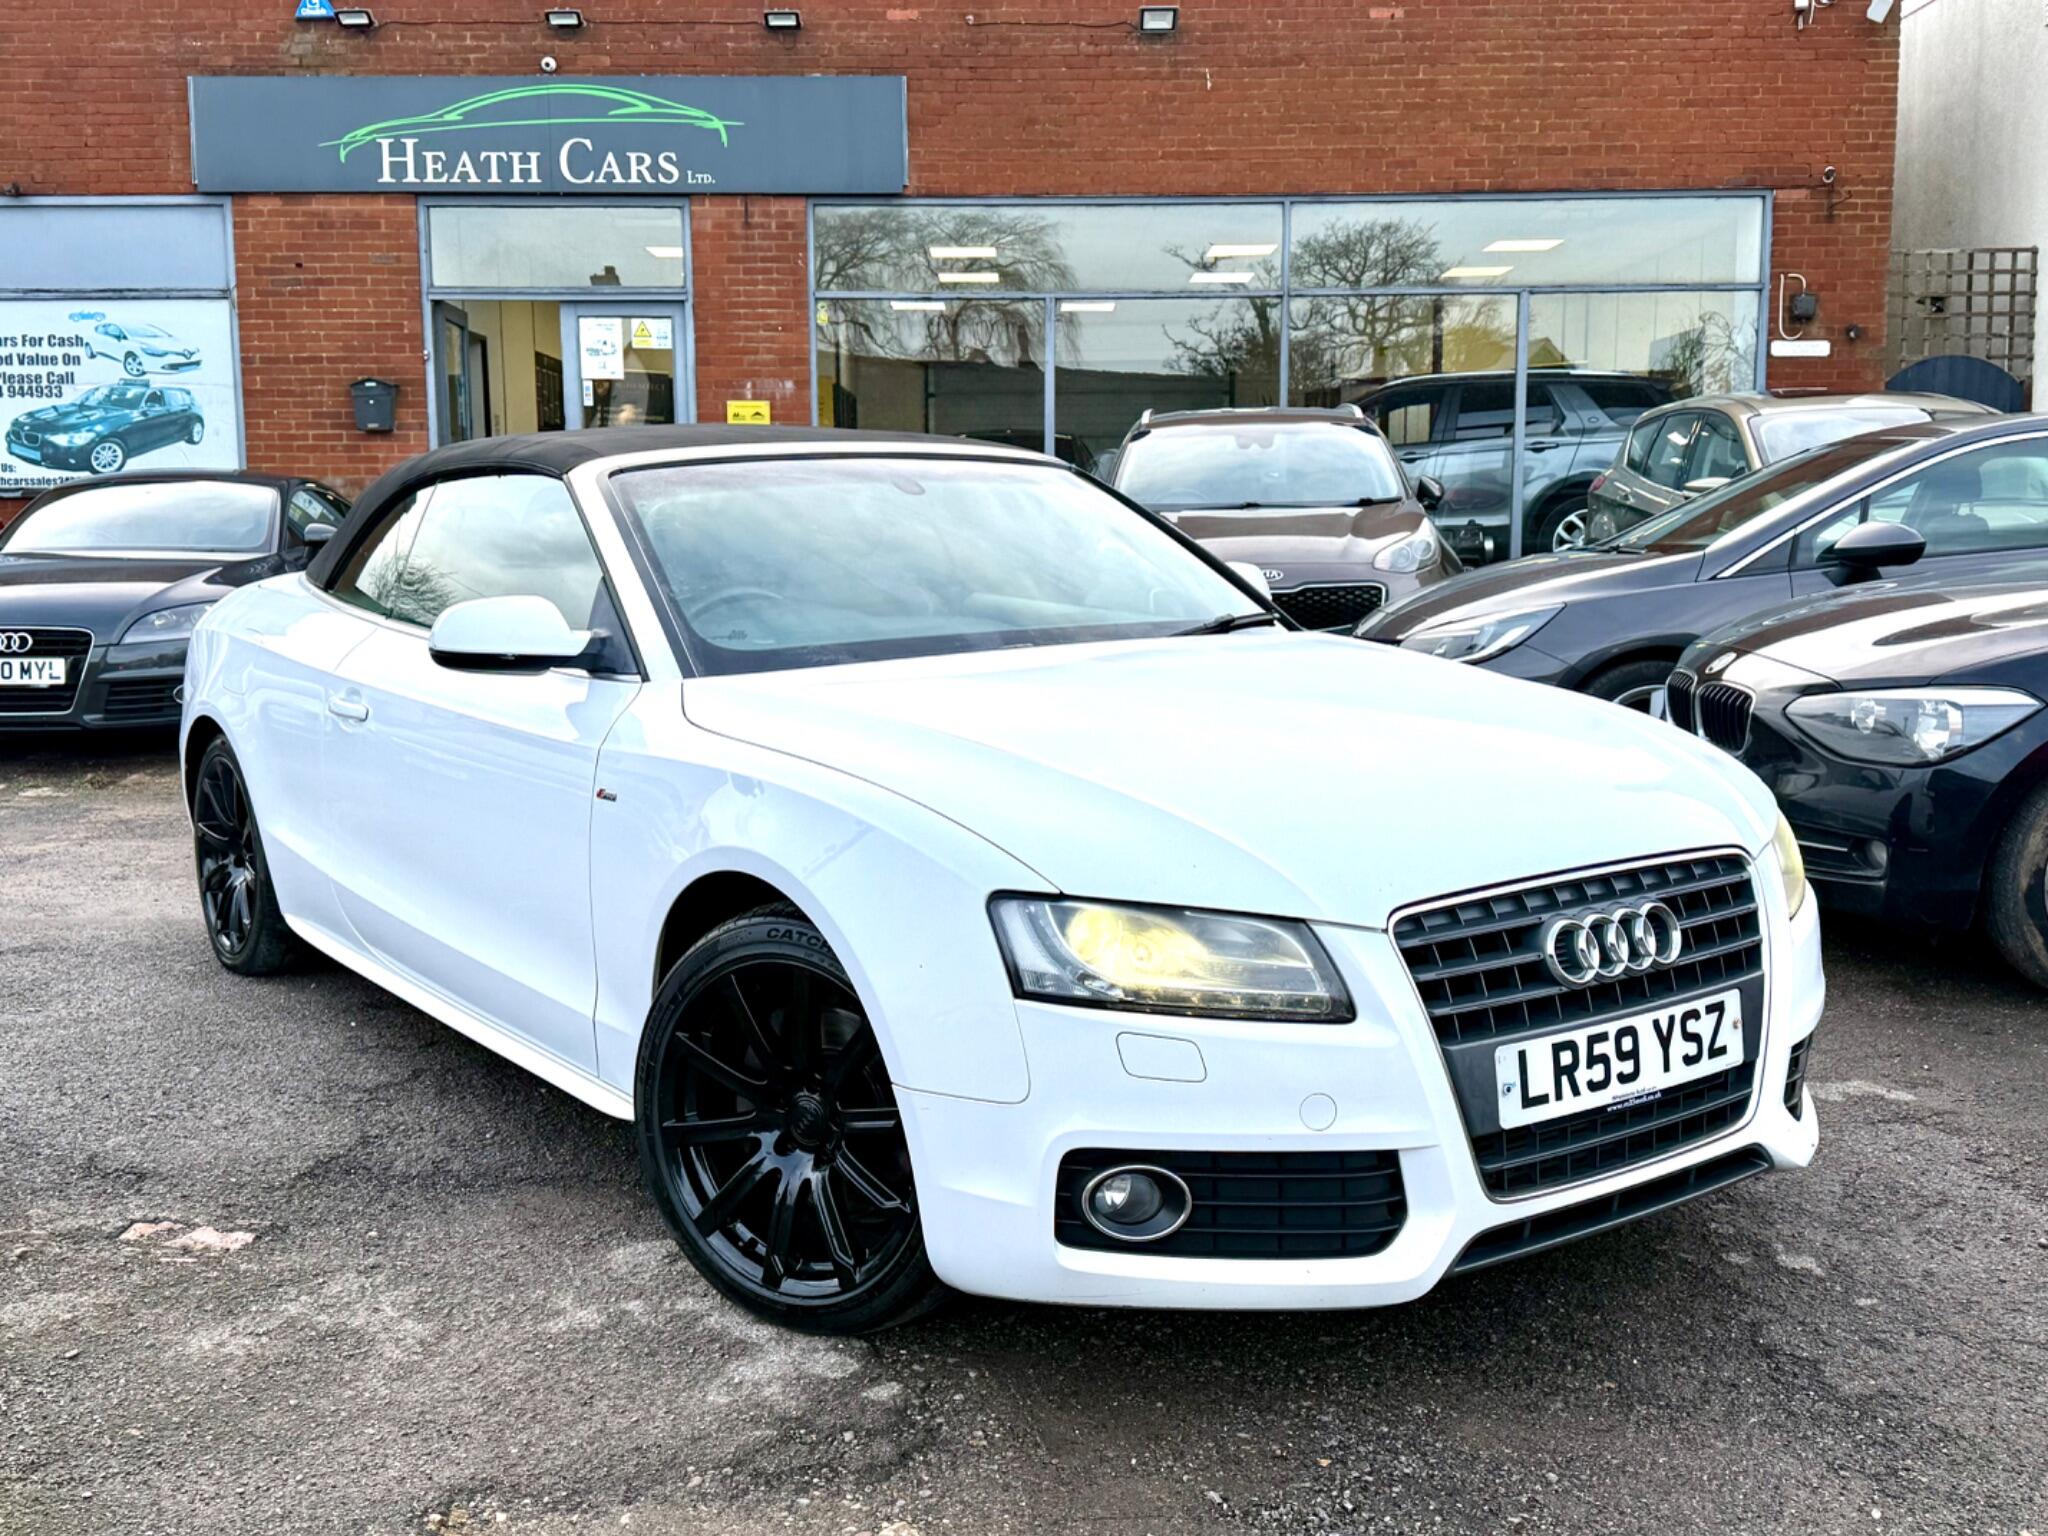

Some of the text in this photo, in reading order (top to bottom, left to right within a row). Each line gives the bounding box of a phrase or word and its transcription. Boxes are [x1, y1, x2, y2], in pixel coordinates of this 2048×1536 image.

[21, 334, 44, 348] For
[47, 333, 84, 348] Cash
[16, 353, 59, 366] Value
[62, 352, 81, 366] On
[0, 371, 75, 385] lease Call
[7, 385, 63, 398] 944933
[1, 462, 17, 473] Us:
[20, 660, 61, 680] MYL
[1517, 999, 1728, 1110] LR59 YSZ
